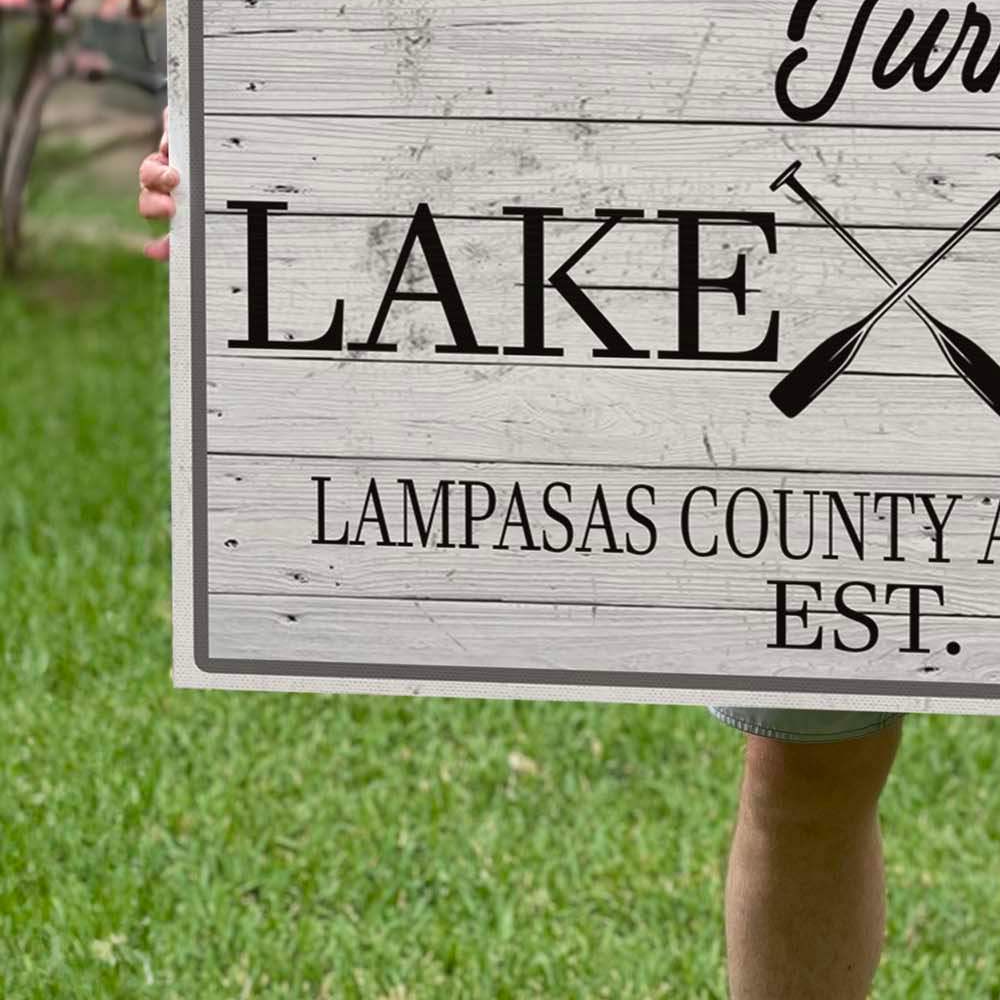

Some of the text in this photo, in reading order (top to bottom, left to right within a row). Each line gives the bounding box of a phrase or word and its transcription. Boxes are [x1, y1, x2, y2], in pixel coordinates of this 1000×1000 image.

[226, 200, 780, 362] LAKE
[311, 476, 658, 556] LAMPASAS
[681, 486, 963, 567] COUNTY
[766, 580, 961, 656] EST.
